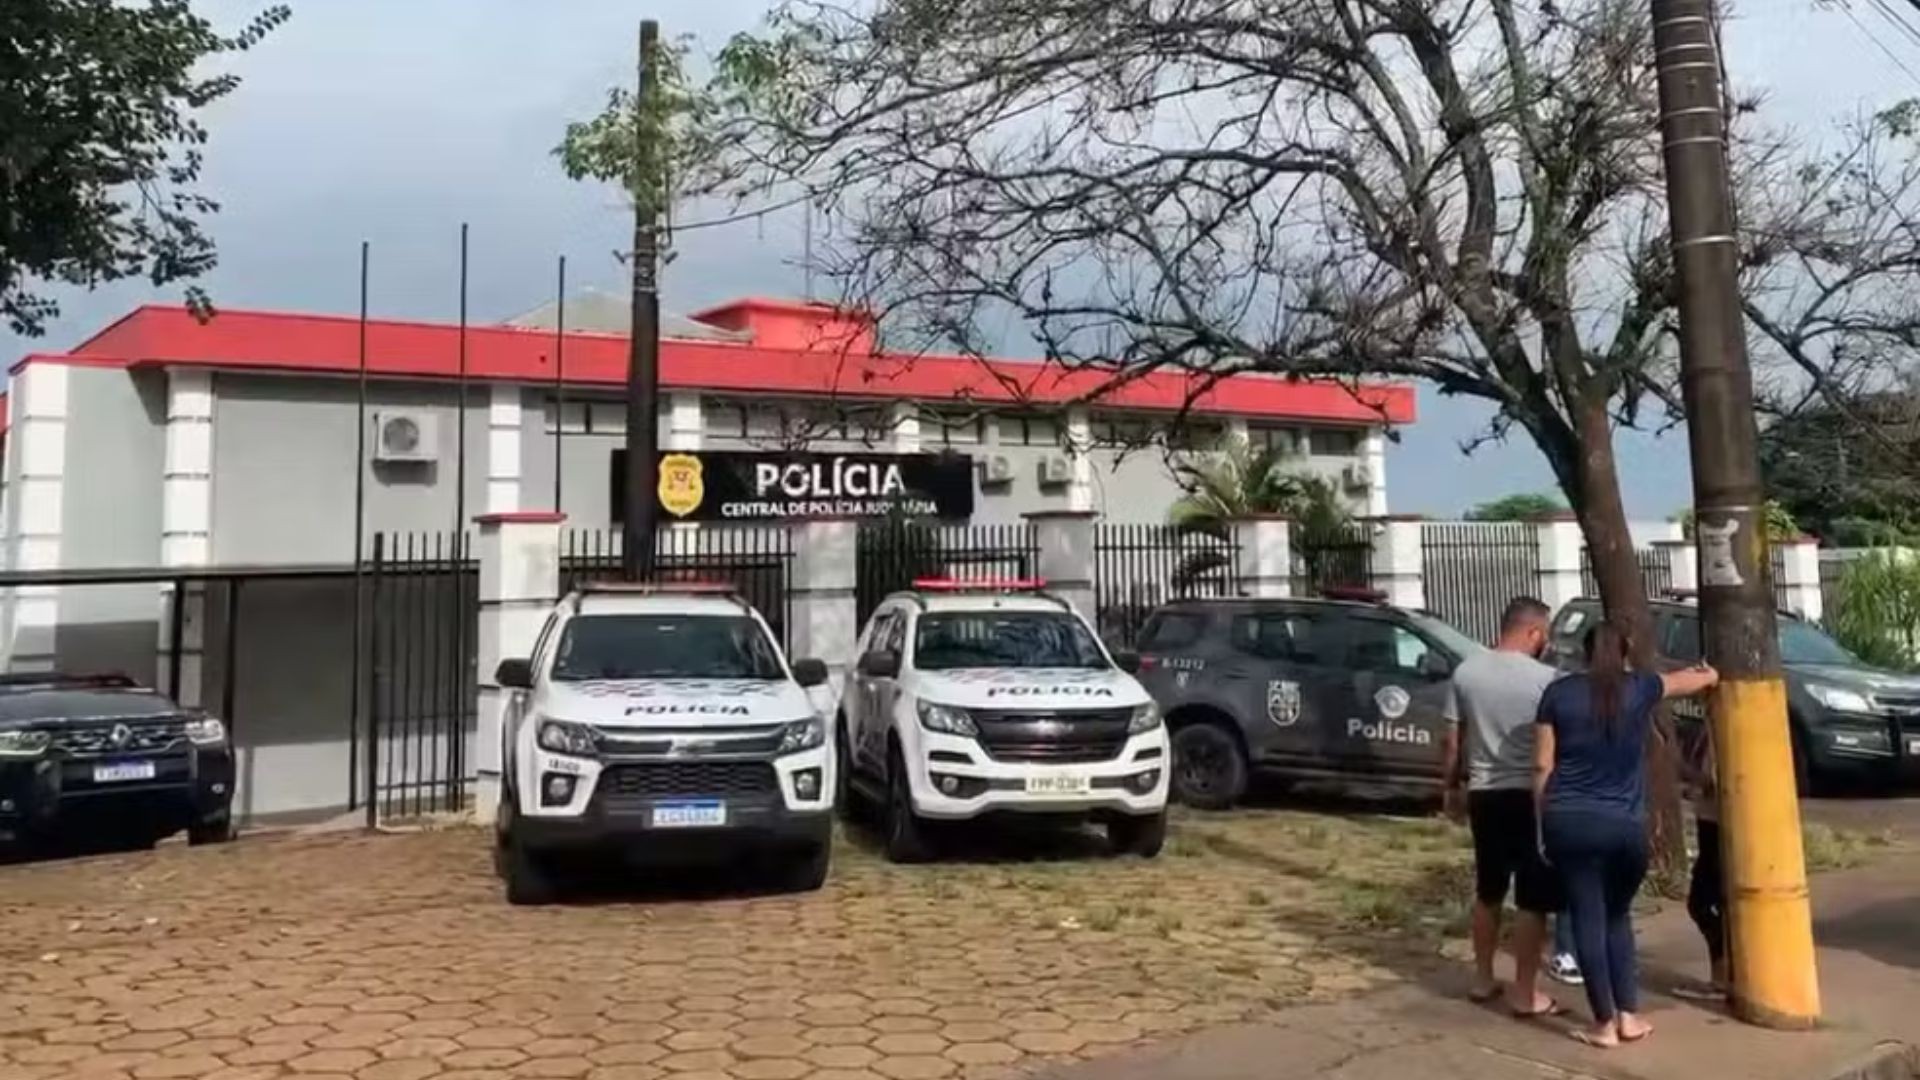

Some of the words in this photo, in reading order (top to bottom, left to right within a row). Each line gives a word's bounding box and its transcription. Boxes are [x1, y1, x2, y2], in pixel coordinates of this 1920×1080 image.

[756, 457, 905, 497] POLÍCIA
[721, 502, 786, 517] CENTRAL
[788, 502, 806, 515] DE
